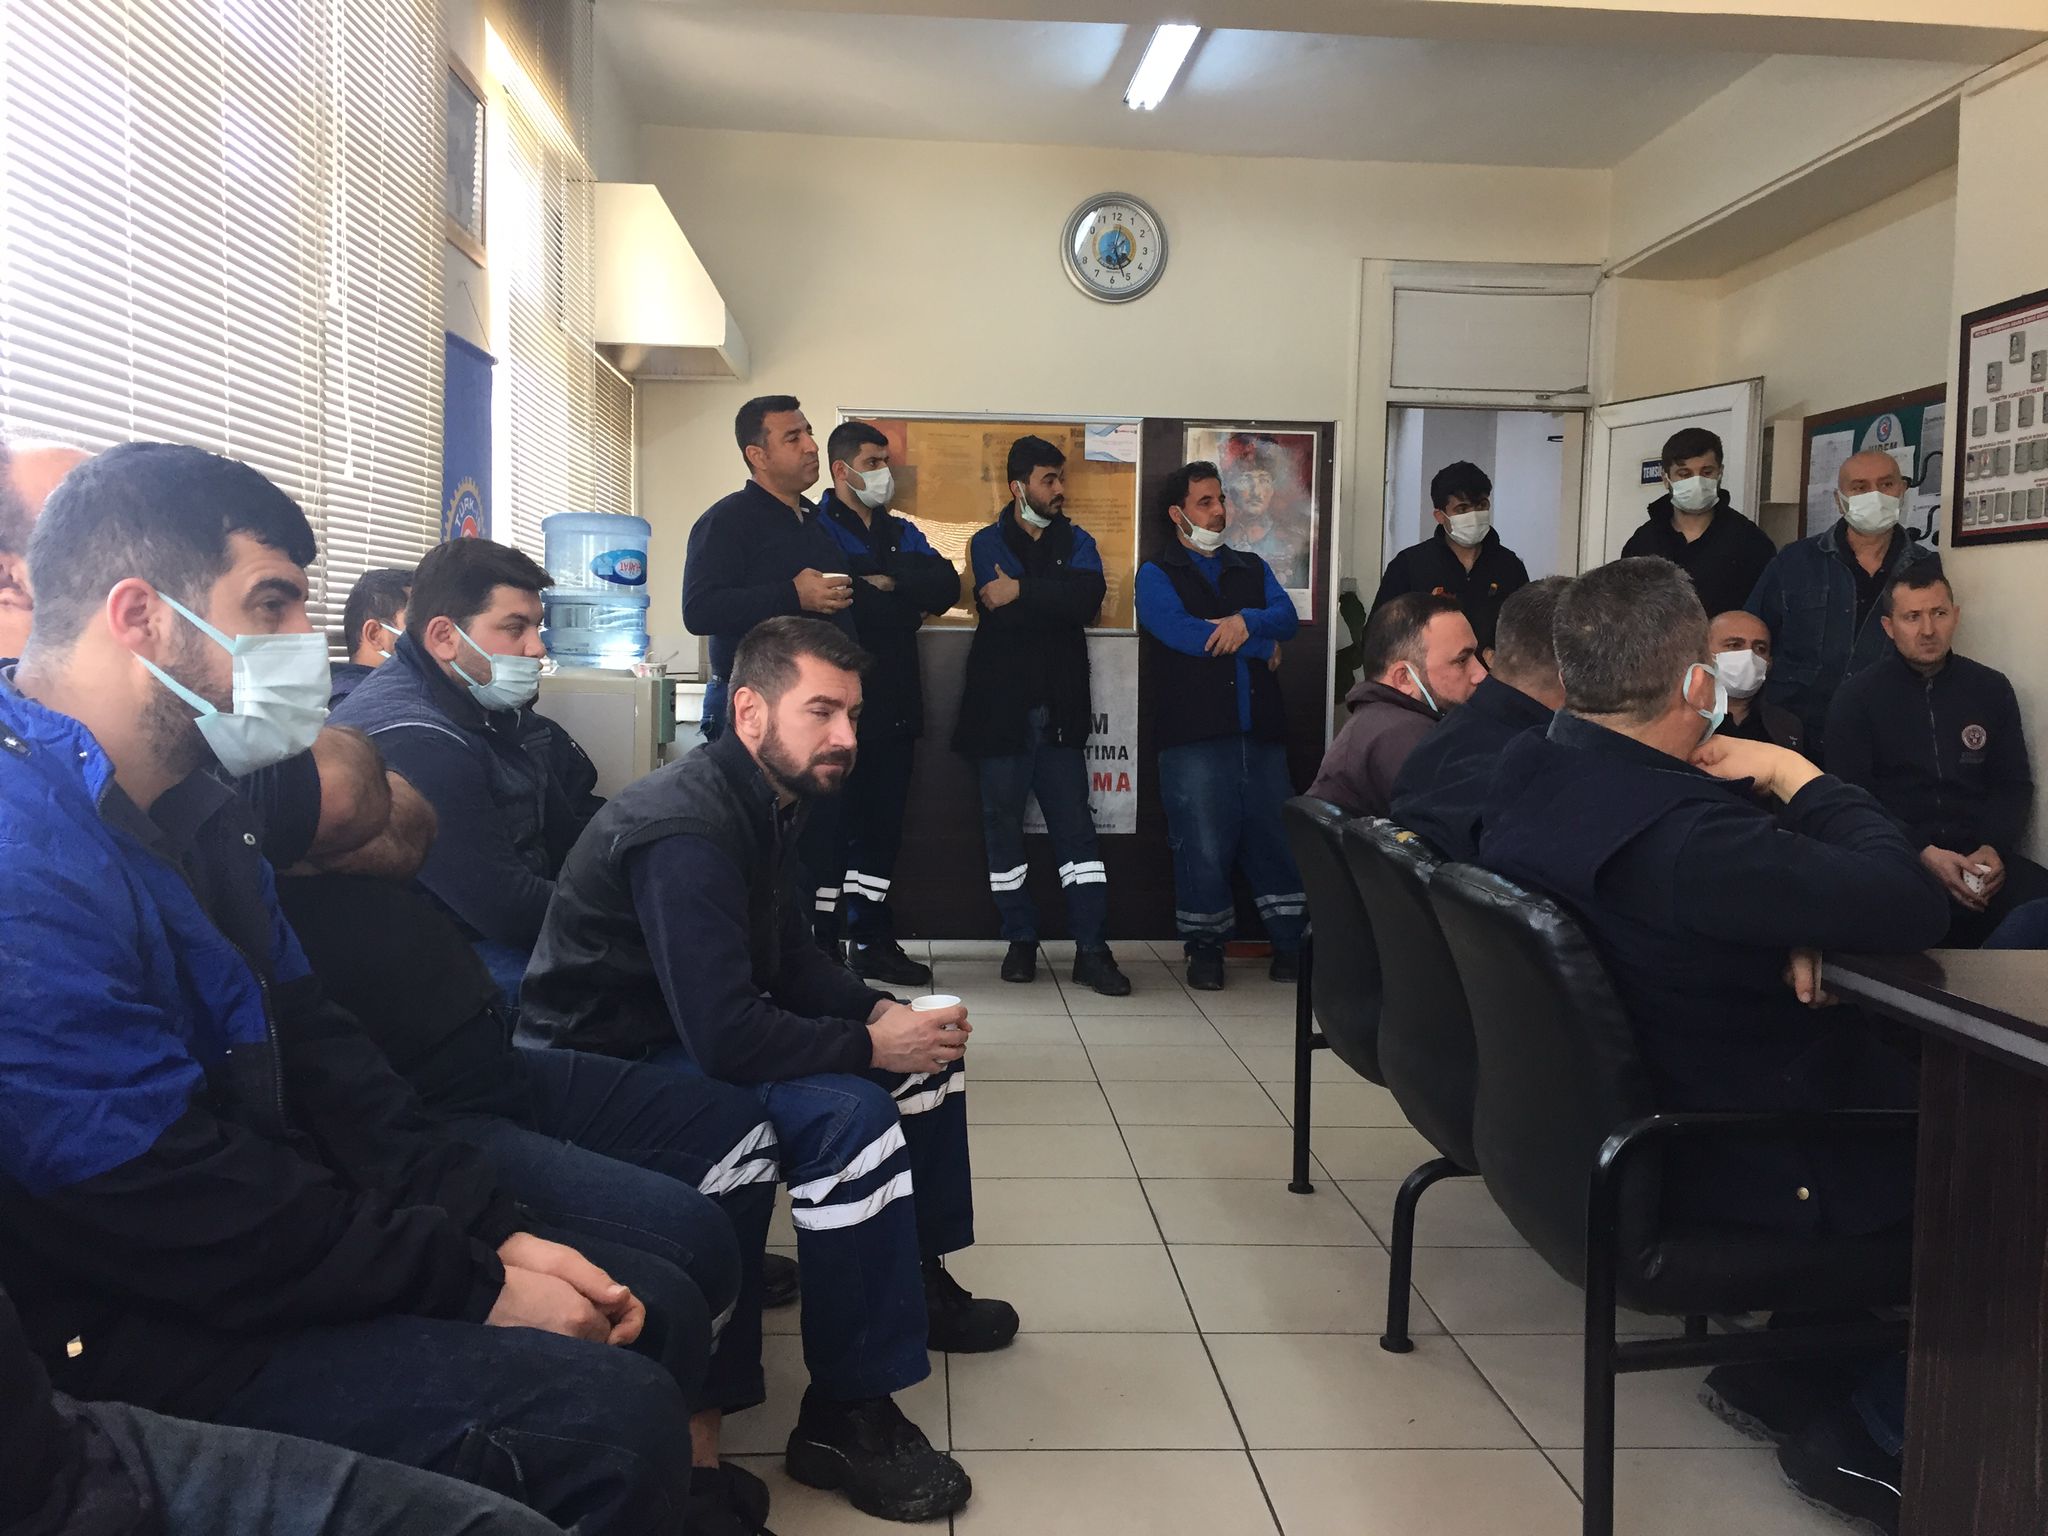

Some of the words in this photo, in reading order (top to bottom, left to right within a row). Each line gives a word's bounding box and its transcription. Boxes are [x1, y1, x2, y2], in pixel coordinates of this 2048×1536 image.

[1112, 212, 1122, 221] 12
[1130, 217, 1134, 225] 1
[1140, 229, 1145, 238] 2
[1142, 247, 1148, 255] 3
[1082, 256, 1088, 264] 8
[1137, 262, 1143, 271] 4
[1094, 269, 1100, 277] 7
[1125, 272, 1131, 281] 5
[1109, 275, 1115, 284] 6
[1092, 772, 1131, 792] MA
